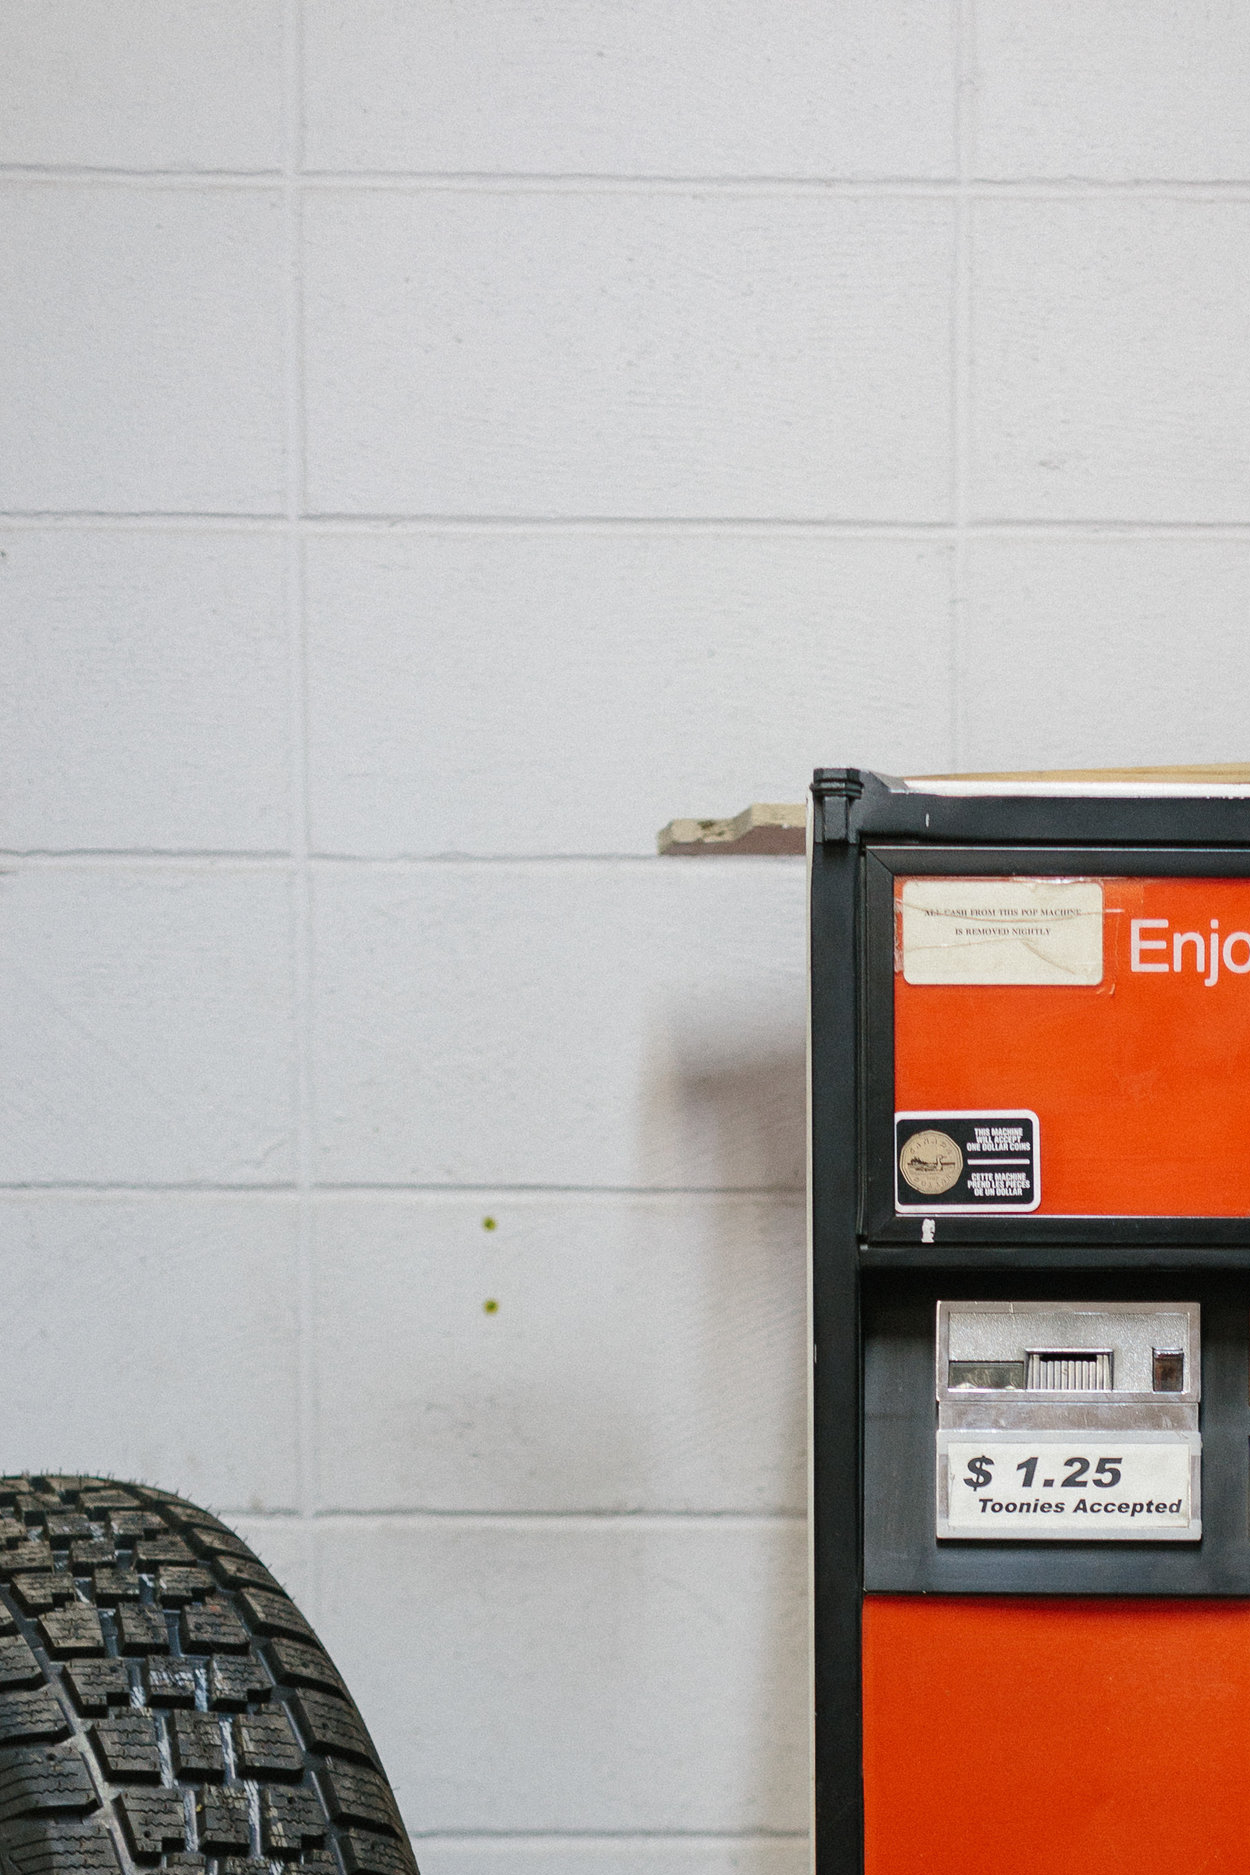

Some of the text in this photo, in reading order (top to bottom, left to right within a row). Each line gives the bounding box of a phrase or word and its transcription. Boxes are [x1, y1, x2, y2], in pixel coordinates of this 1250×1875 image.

[944, 908, 968, 917] CASH
[970, 908, 996, 917] FROM
[999, 908, 1019, 917] THIS
[1021, 908, 1038, 917] POP
[1040, 908, 1082, 917] MACHINE
[955, 927, 1051, 936] IS REMOVED NIGHTLY
[974, 1127, 1024, 1137] THIS MACHINE
[976, 1135, 1021, 1144] WILL ACCEPT
[966, 1142, 1031, 1151] ONE DOLLAR COINS
[971, 1173, 1026, 1181] CETTE MACHINE
[967, 1180, 991, 1189] PREND
[992, 1181, 1004, 1189] LES
[974, 1187, 1022, 1196] DE UN DOLLAR
[963, 1455, 1123, 1492] $ 1.25
[978, 1499, 1182, 1517] Toonies Accepted
